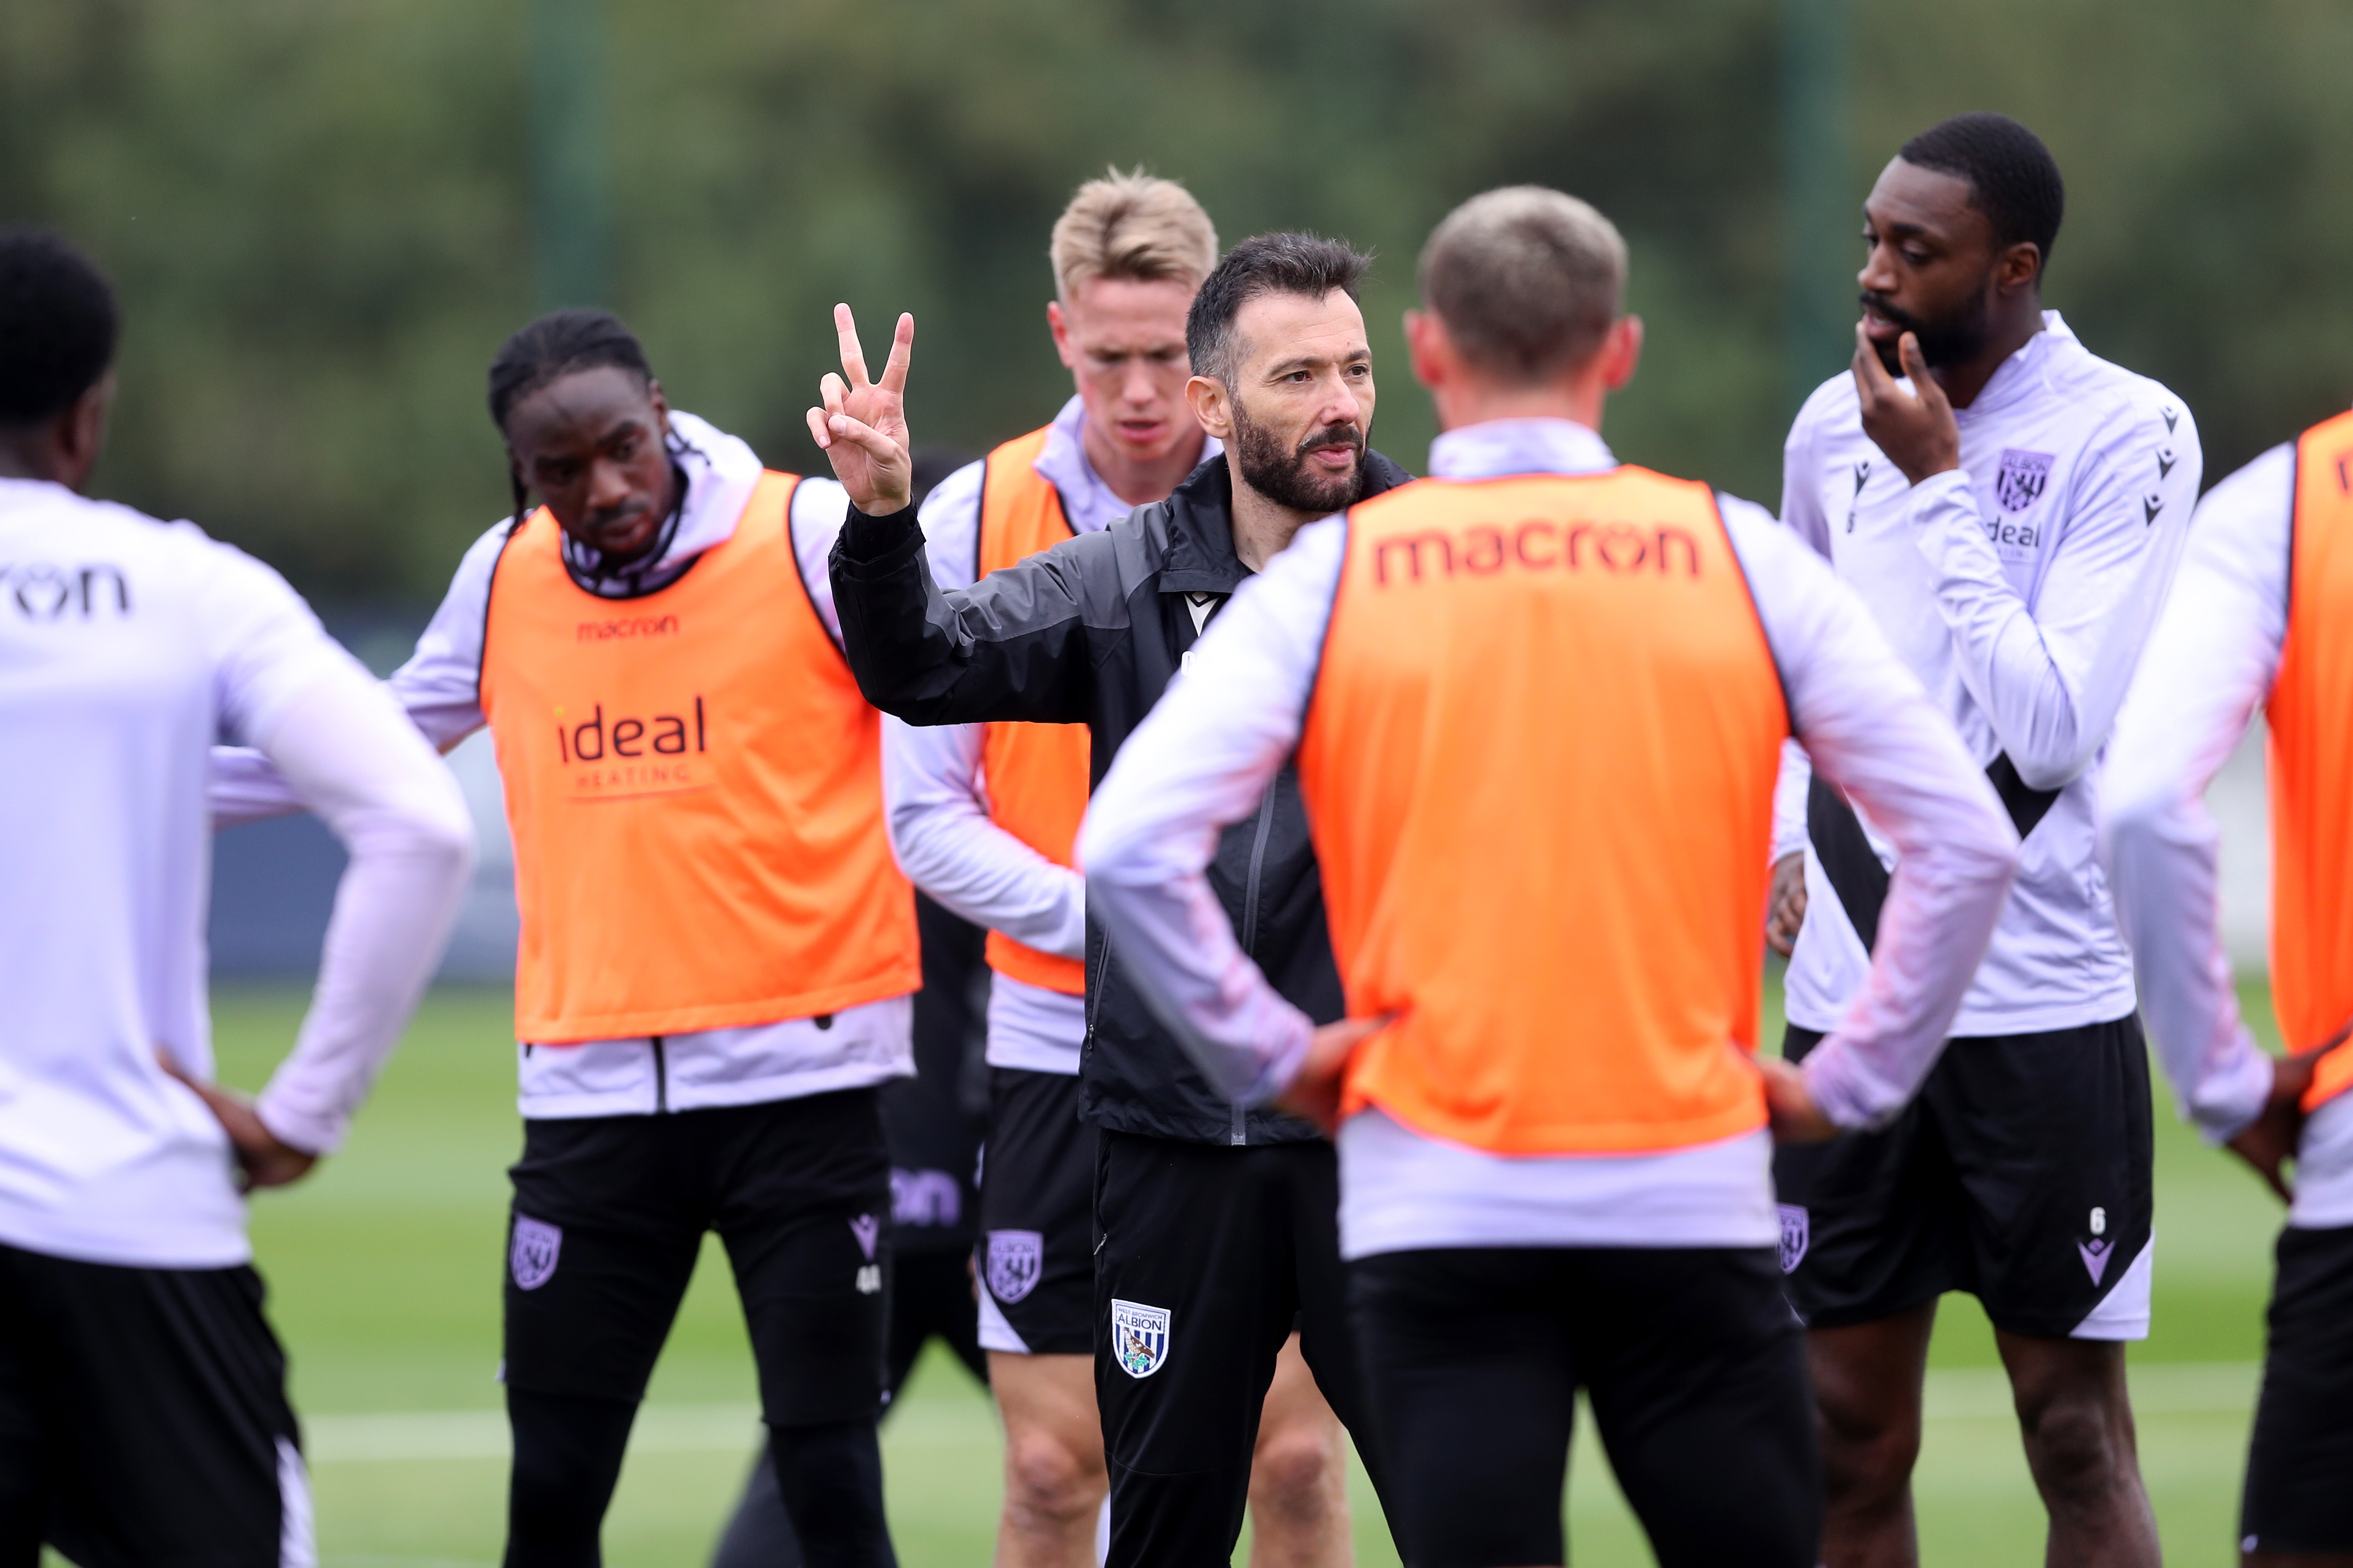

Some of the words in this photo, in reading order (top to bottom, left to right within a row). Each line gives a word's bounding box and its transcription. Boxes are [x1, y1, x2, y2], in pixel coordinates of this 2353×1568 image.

[1986, 516, 2040, 547] deal
[1373, 518, 1702, 587] macron
[576, 615, 680, 642] macron
[556, 696, 705, 763] ideal
[575, 763, 689, 790] HEATING
[2089, 1206, 2106, 1236] 6
[1118, 1313, 1162, 1331] ALBION
